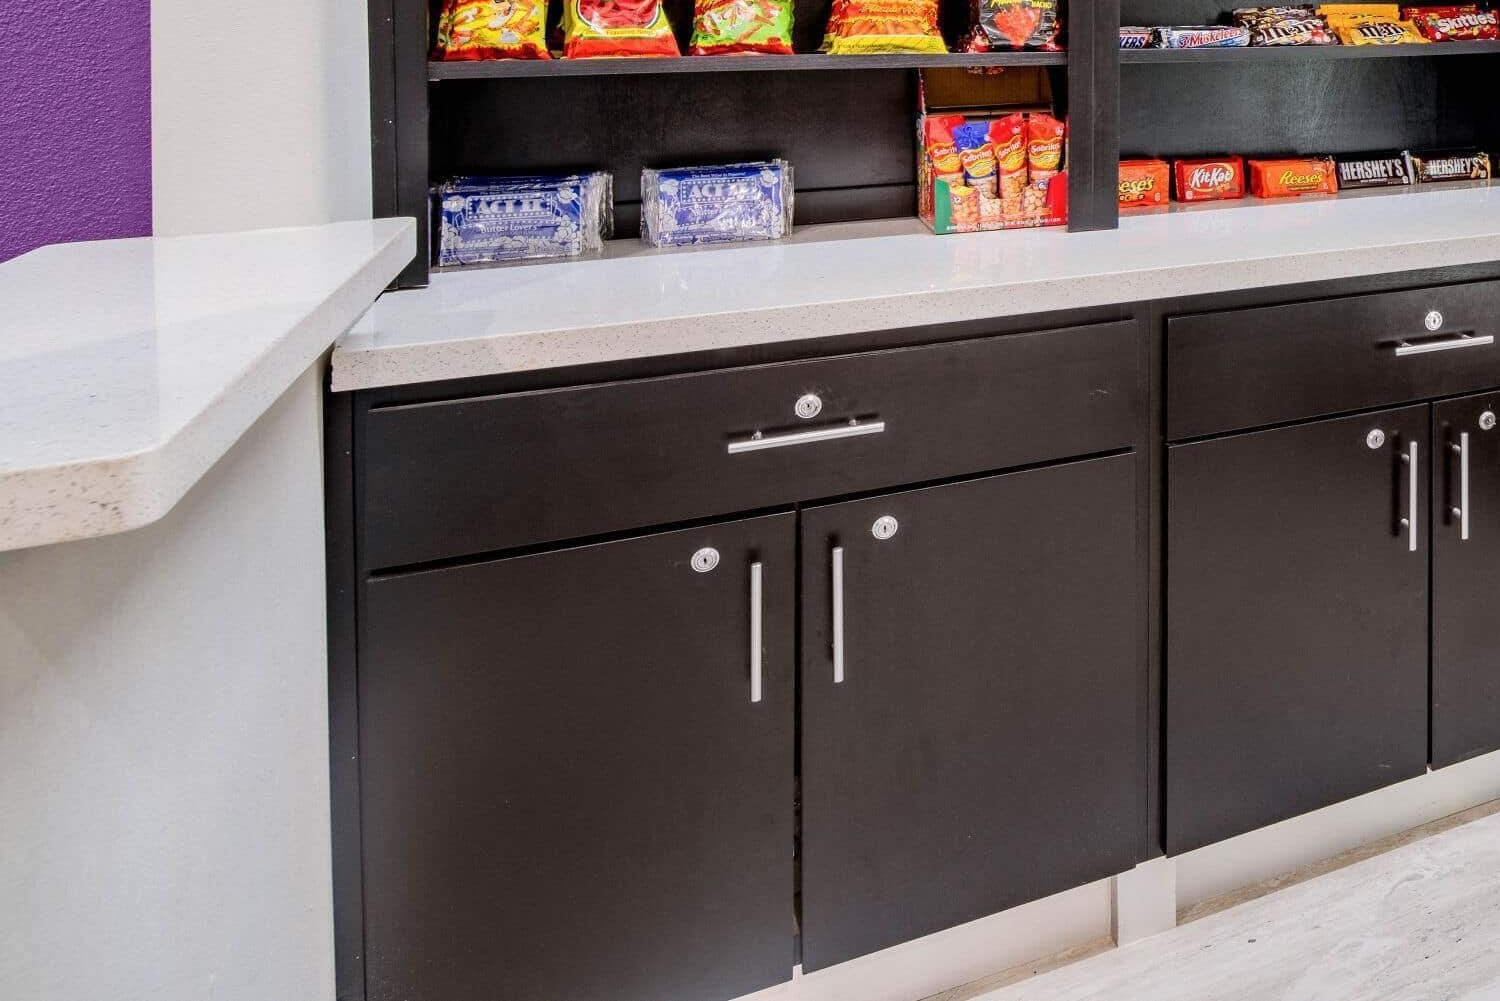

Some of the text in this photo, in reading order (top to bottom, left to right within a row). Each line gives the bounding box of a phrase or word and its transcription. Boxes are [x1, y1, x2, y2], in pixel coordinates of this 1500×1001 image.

[1437, 12, 1496, 33] Skittles
[998, 140, 1022, 158] Sabritas
[1031, 142, 1060, 154] Sabritas
[961, 149, 993, 164] Sabritas
[1340, 157, 1404, 182] HERSHEY'S
[1429, 157, 1479, 177] HERSHEY'S
[1279, 169, 1323, 185] Reese's
[690, 183, 723, 199] ACT
[477, 199, 543, 215] ACT II
